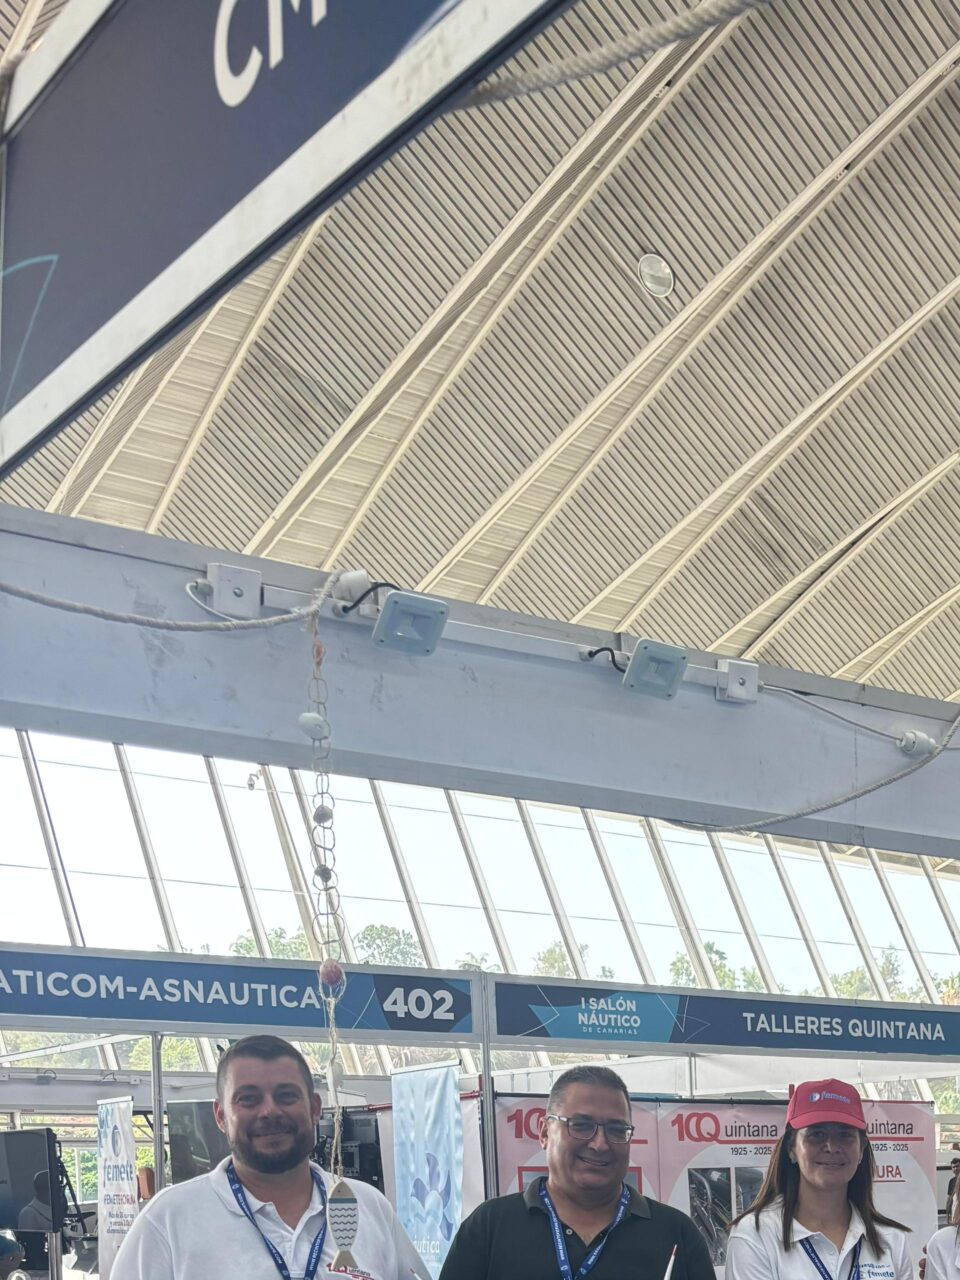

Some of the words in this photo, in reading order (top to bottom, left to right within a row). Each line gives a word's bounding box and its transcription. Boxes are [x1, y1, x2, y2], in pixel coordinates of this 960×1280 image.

[383, 987, 454, 1020] 402
[581, 997, 585, 1009] I
[589, 996, 636, 1012] SALÓN
[578, 1010, 641, 1028] NÁUTICO
[597, 1027, 638, 1035] CANARIAS
[742, 1012, 843, 1037] TALLERES
[848, 1018, 945, 1041] QUINTANA
[731, 1147, 748, 1156] 1925
[754, 1146, 772, 1155] 2025
[872, 1143, 888, 1152] 1925
[893, 1143, 909, 1151] 2025
[873, 1165, 903, 1178] URA
